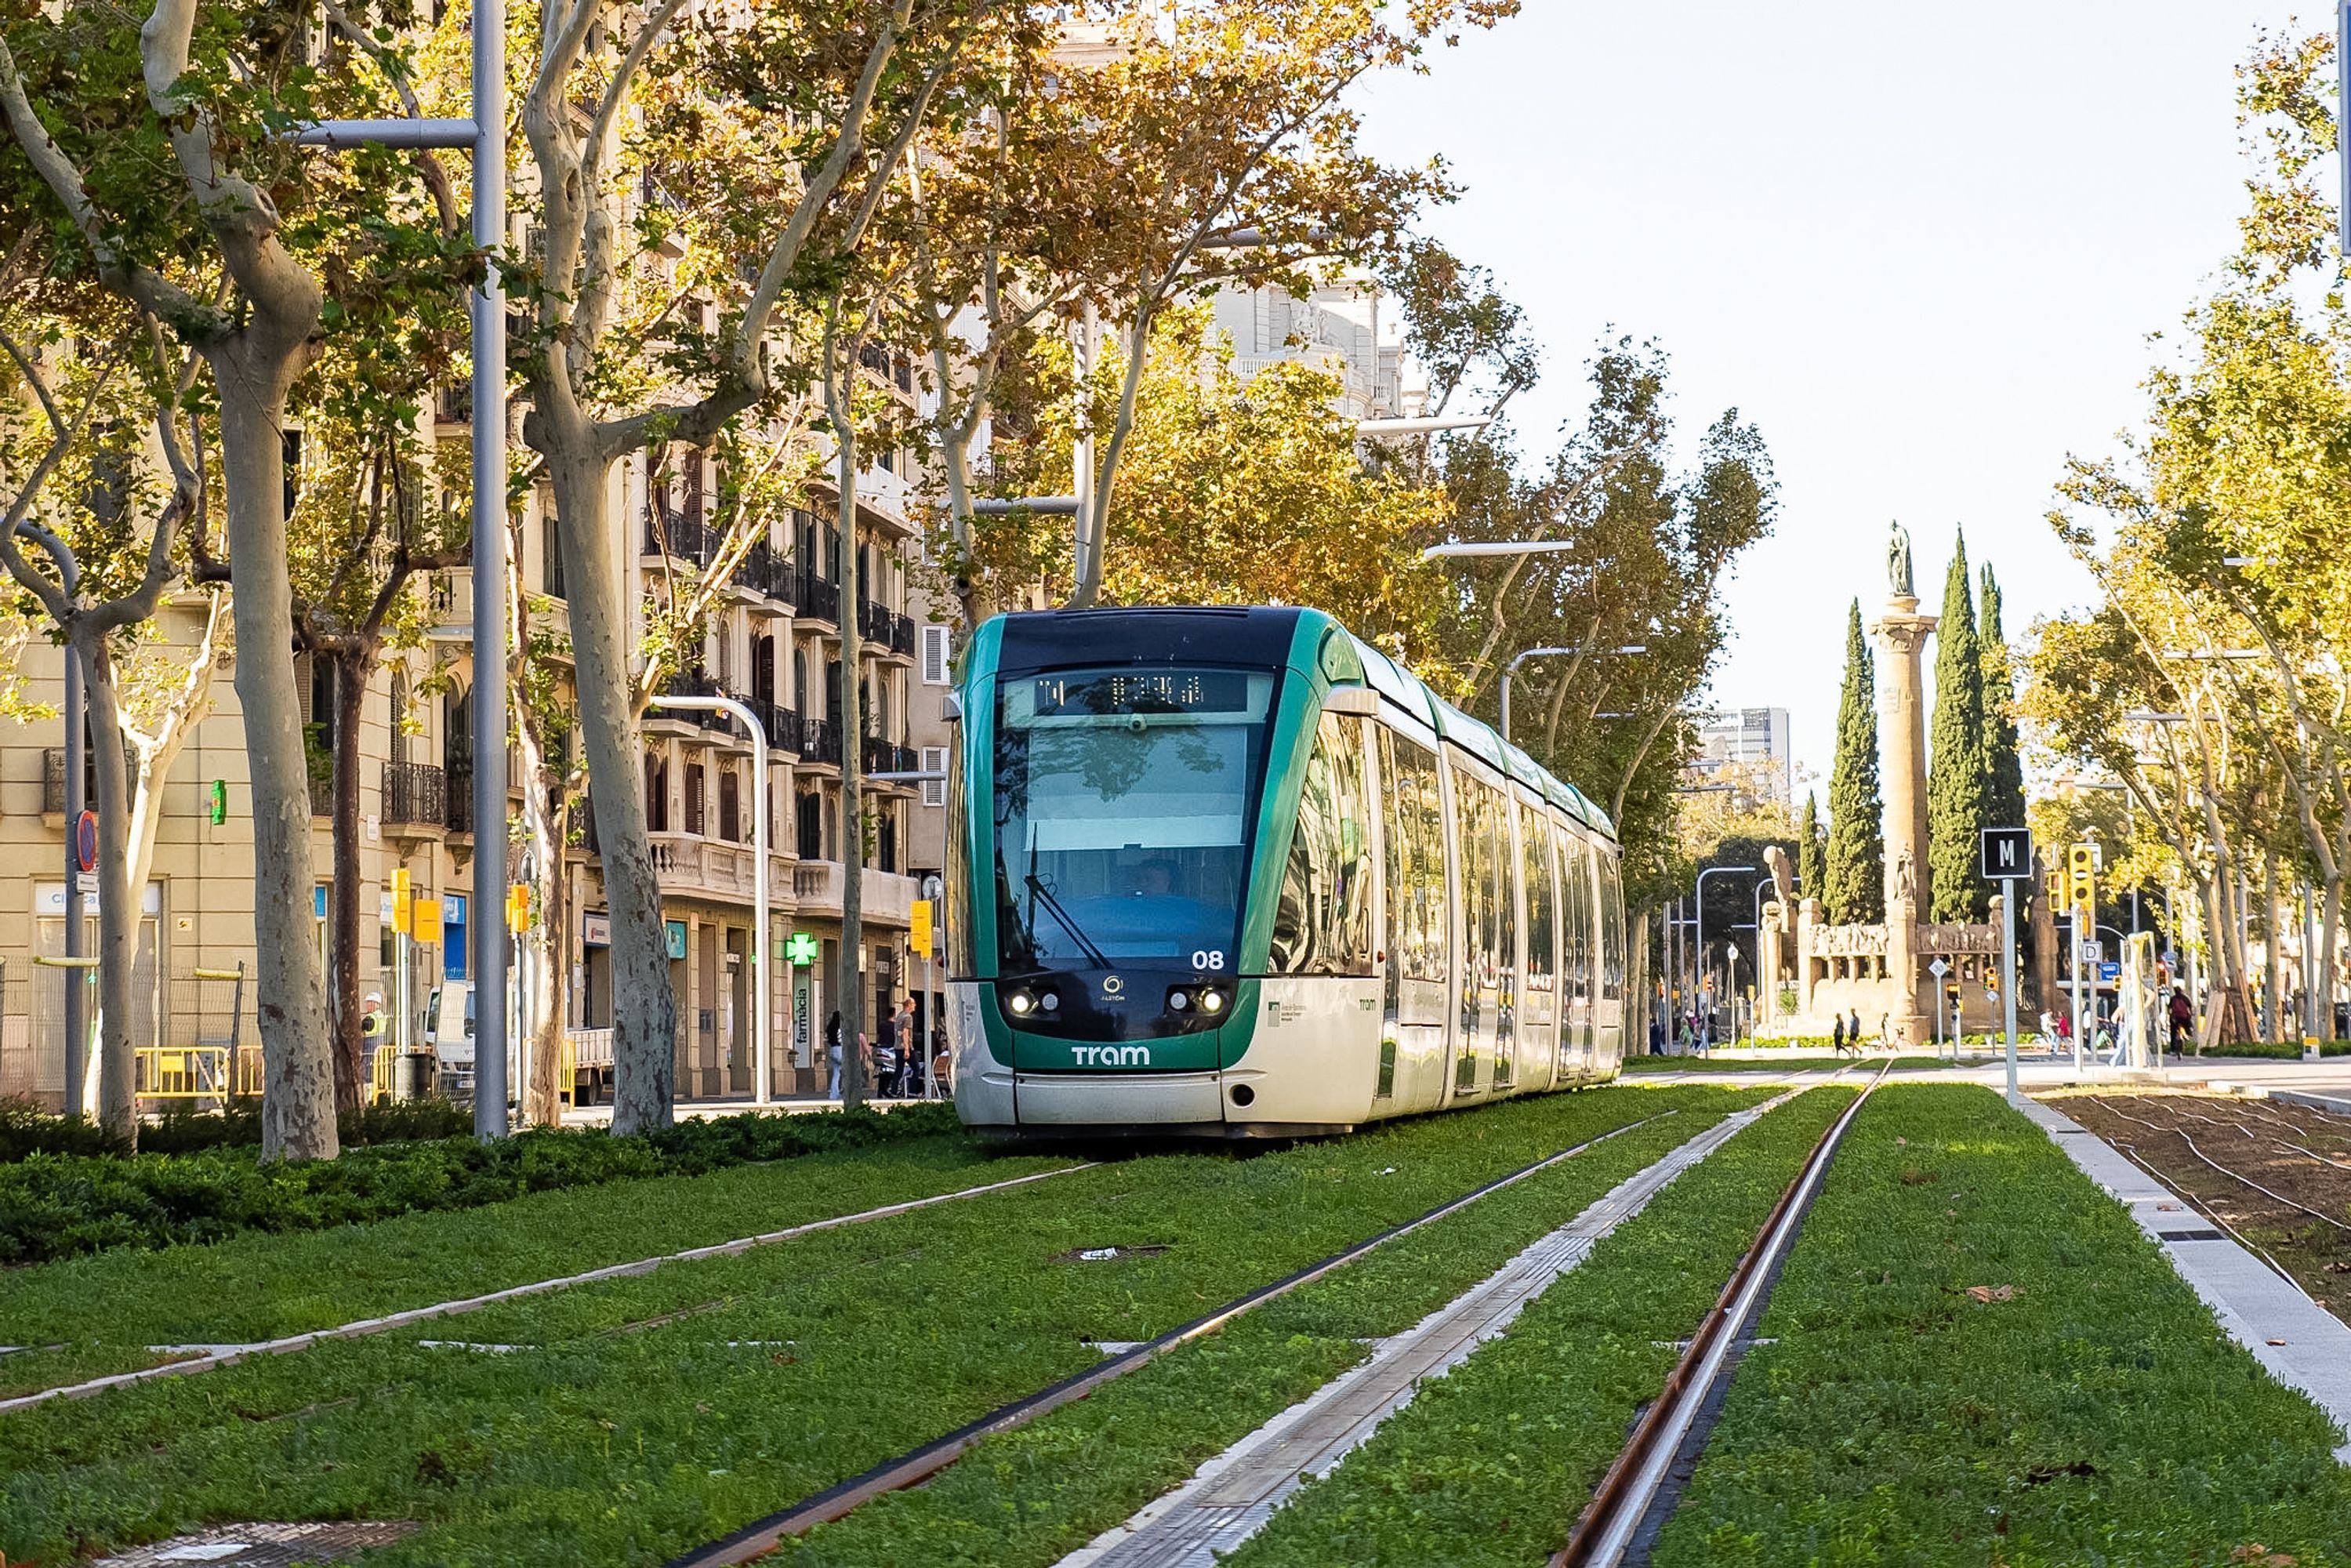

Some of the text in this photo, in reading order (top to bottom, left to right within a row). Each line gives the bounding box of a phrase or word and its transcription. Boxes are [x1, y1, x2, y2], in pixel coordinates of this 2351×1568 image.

[2000, 840, 2015, 867] M
[1192, 950, 1224, 970] 08
[2086, 946, 2096, 958] D
[796, 989, 807, 1044] farmàcia
[1072, 1046, 1150, 1065] Tram
